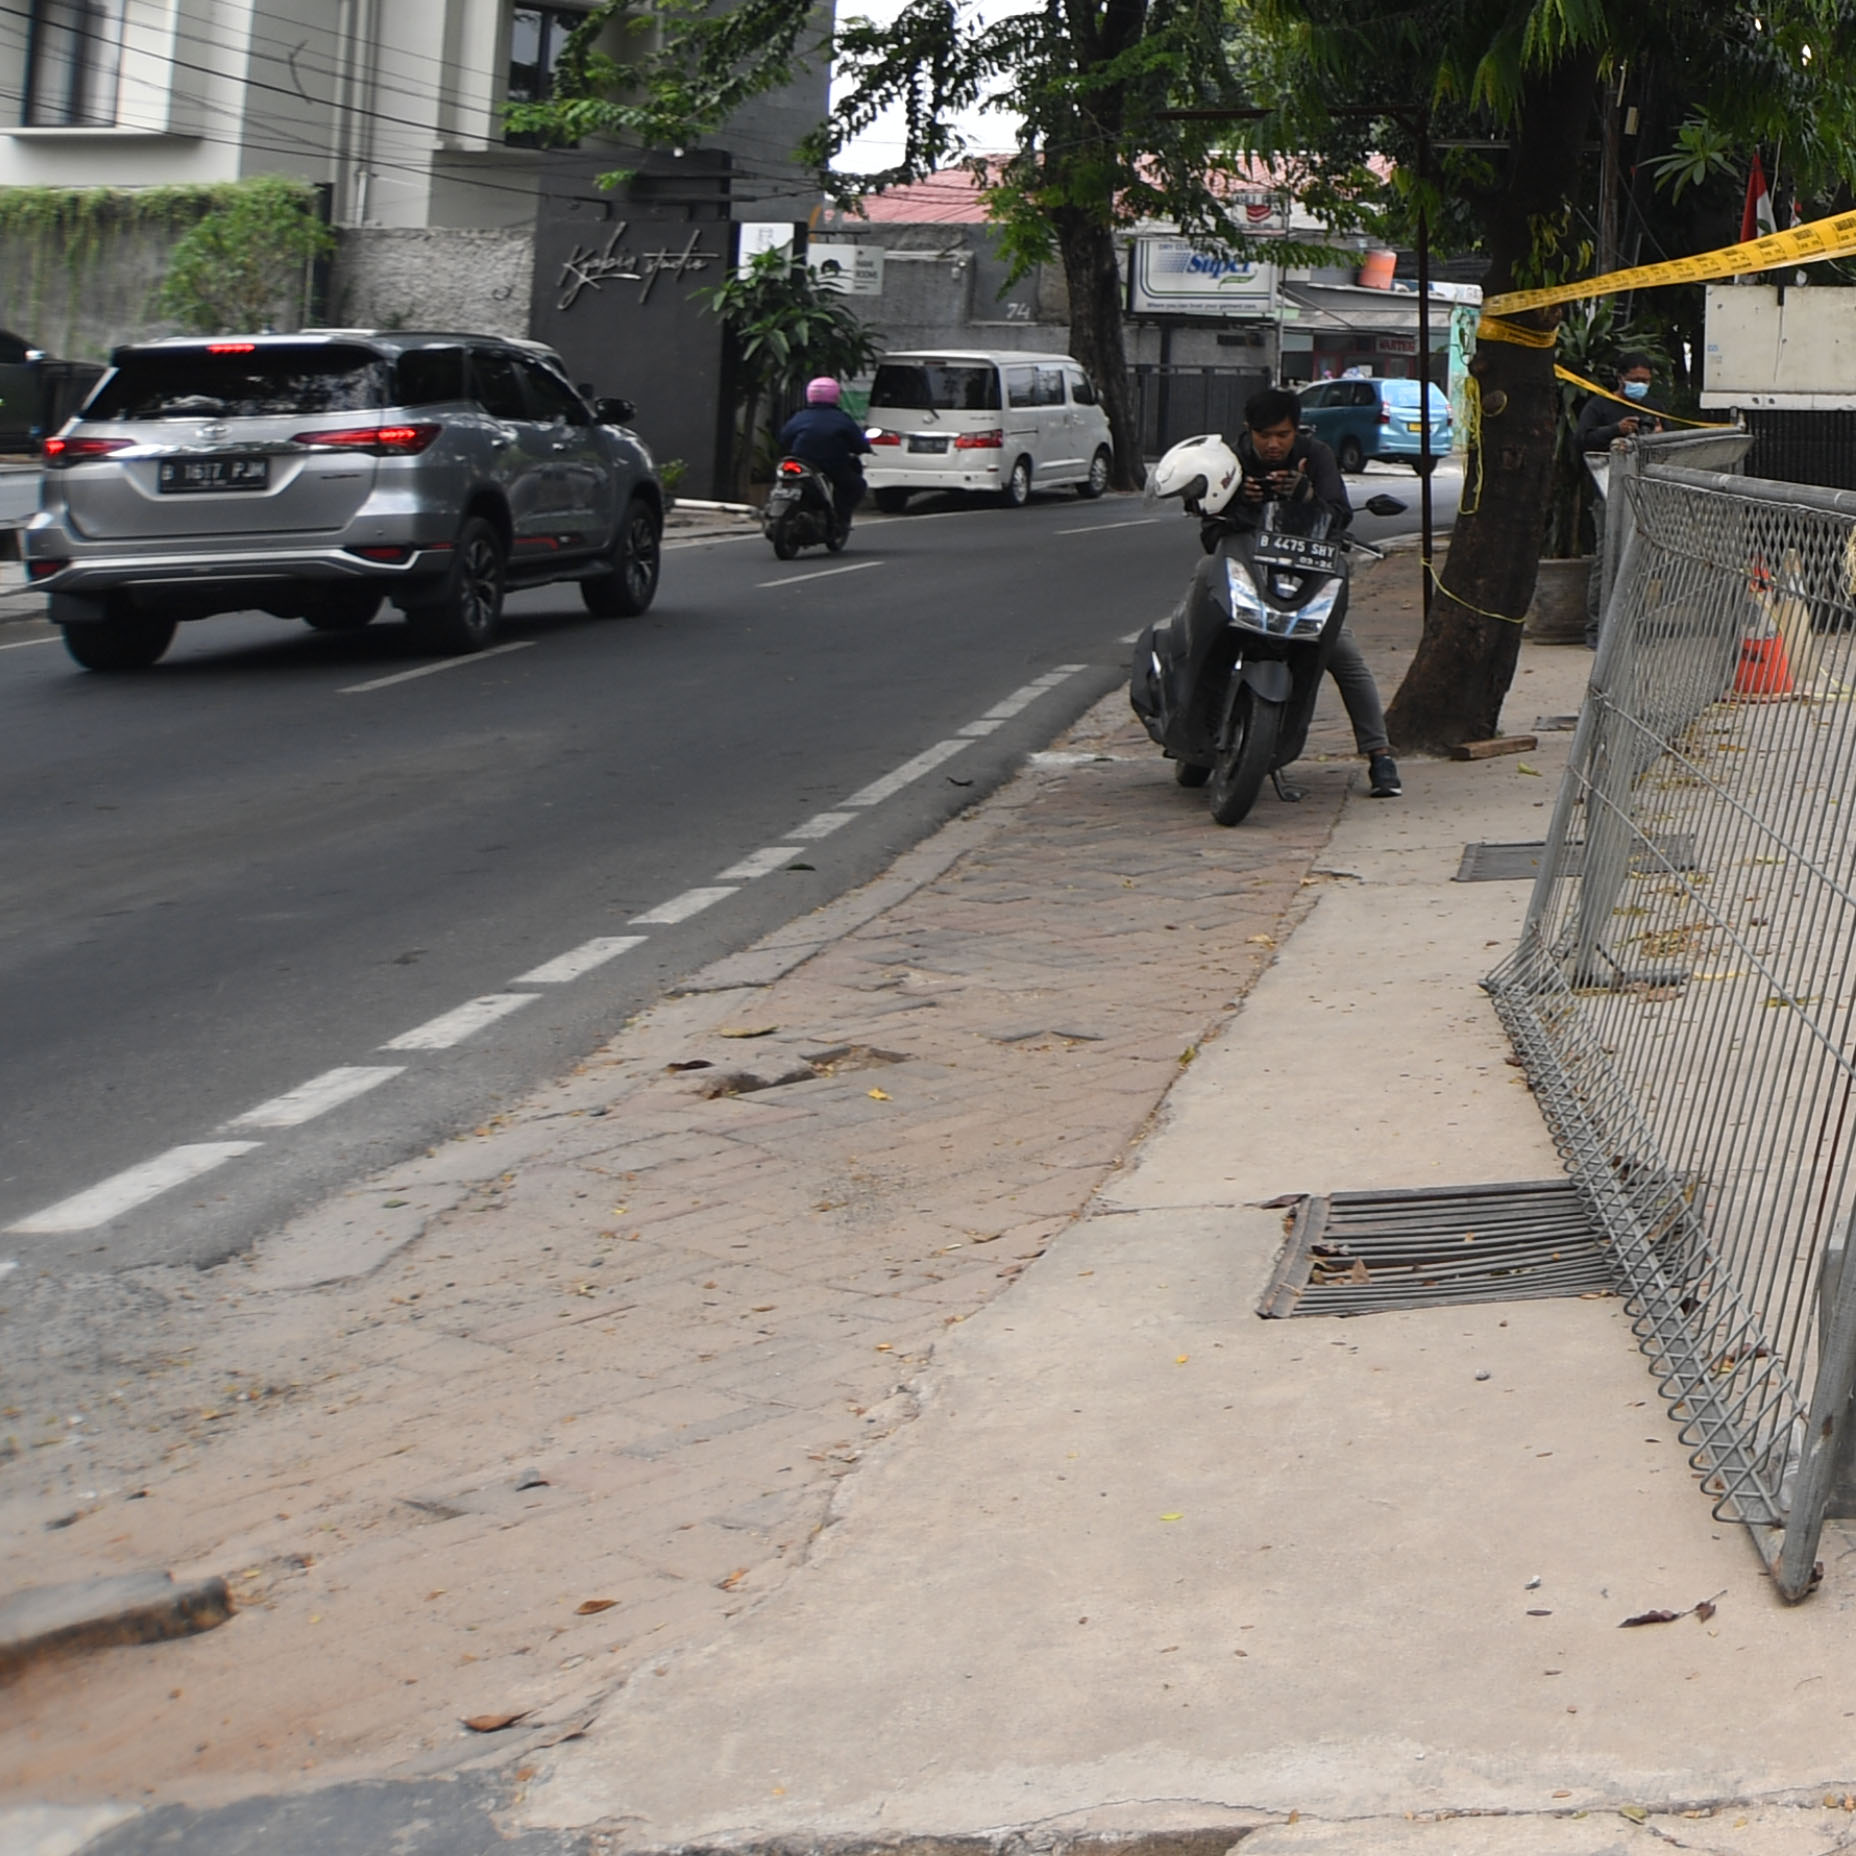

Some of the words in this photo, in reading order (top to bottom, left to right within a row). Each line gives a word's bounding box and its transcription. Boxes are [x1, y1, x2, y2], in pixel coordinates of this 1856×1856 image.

[1006, 302, 1031, 320] 74
[1260, 535, 1269, 547] B
[1273, 537, 1306, 552] 4475
[1311, 543, 1336, 557] SHY
